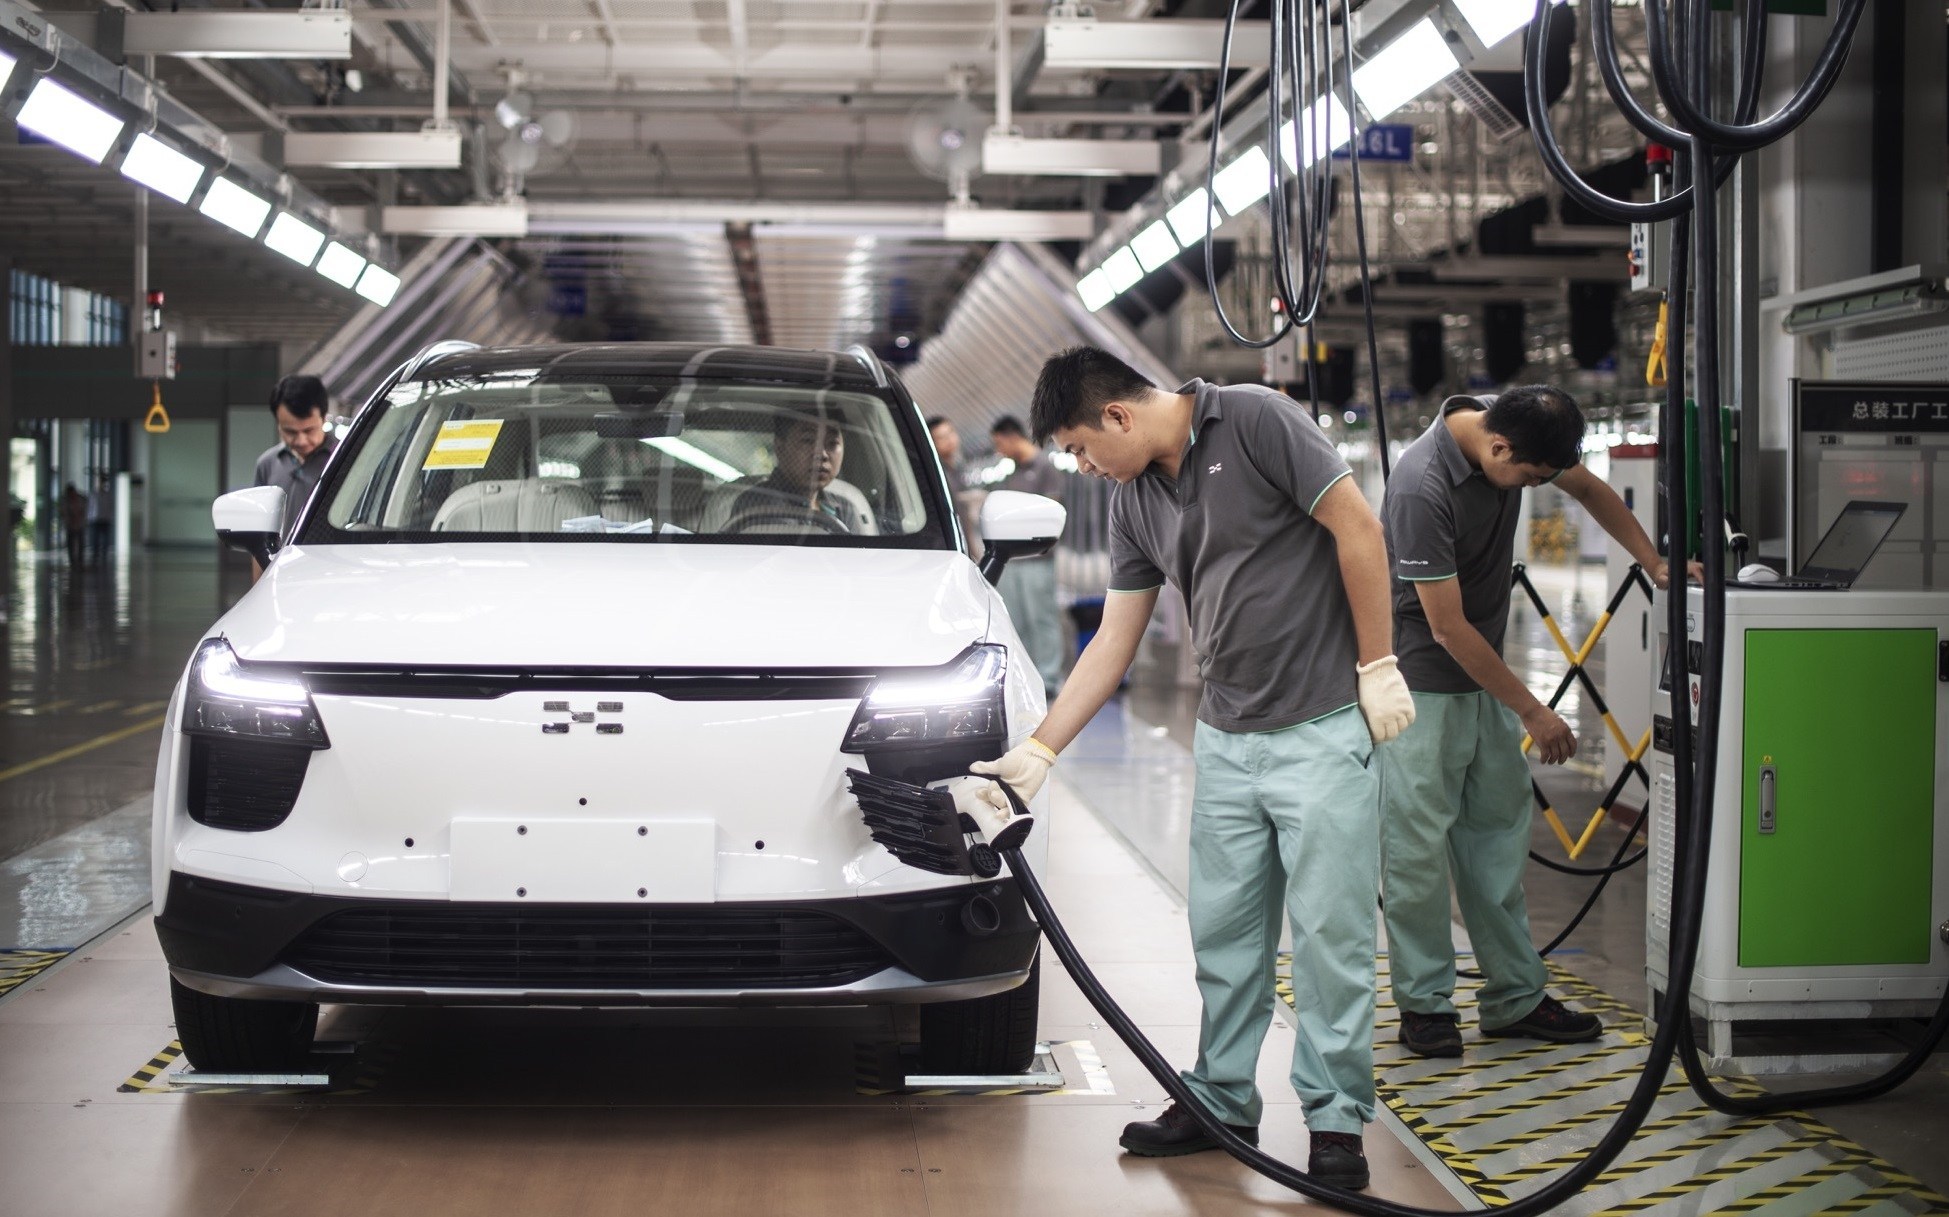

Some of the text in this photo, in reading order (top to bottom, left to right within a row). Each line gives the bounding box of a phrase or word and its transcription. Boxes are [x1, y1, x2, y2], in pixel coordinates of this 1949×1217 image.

[1852, 401, 1948, 419] 总装工厂工
